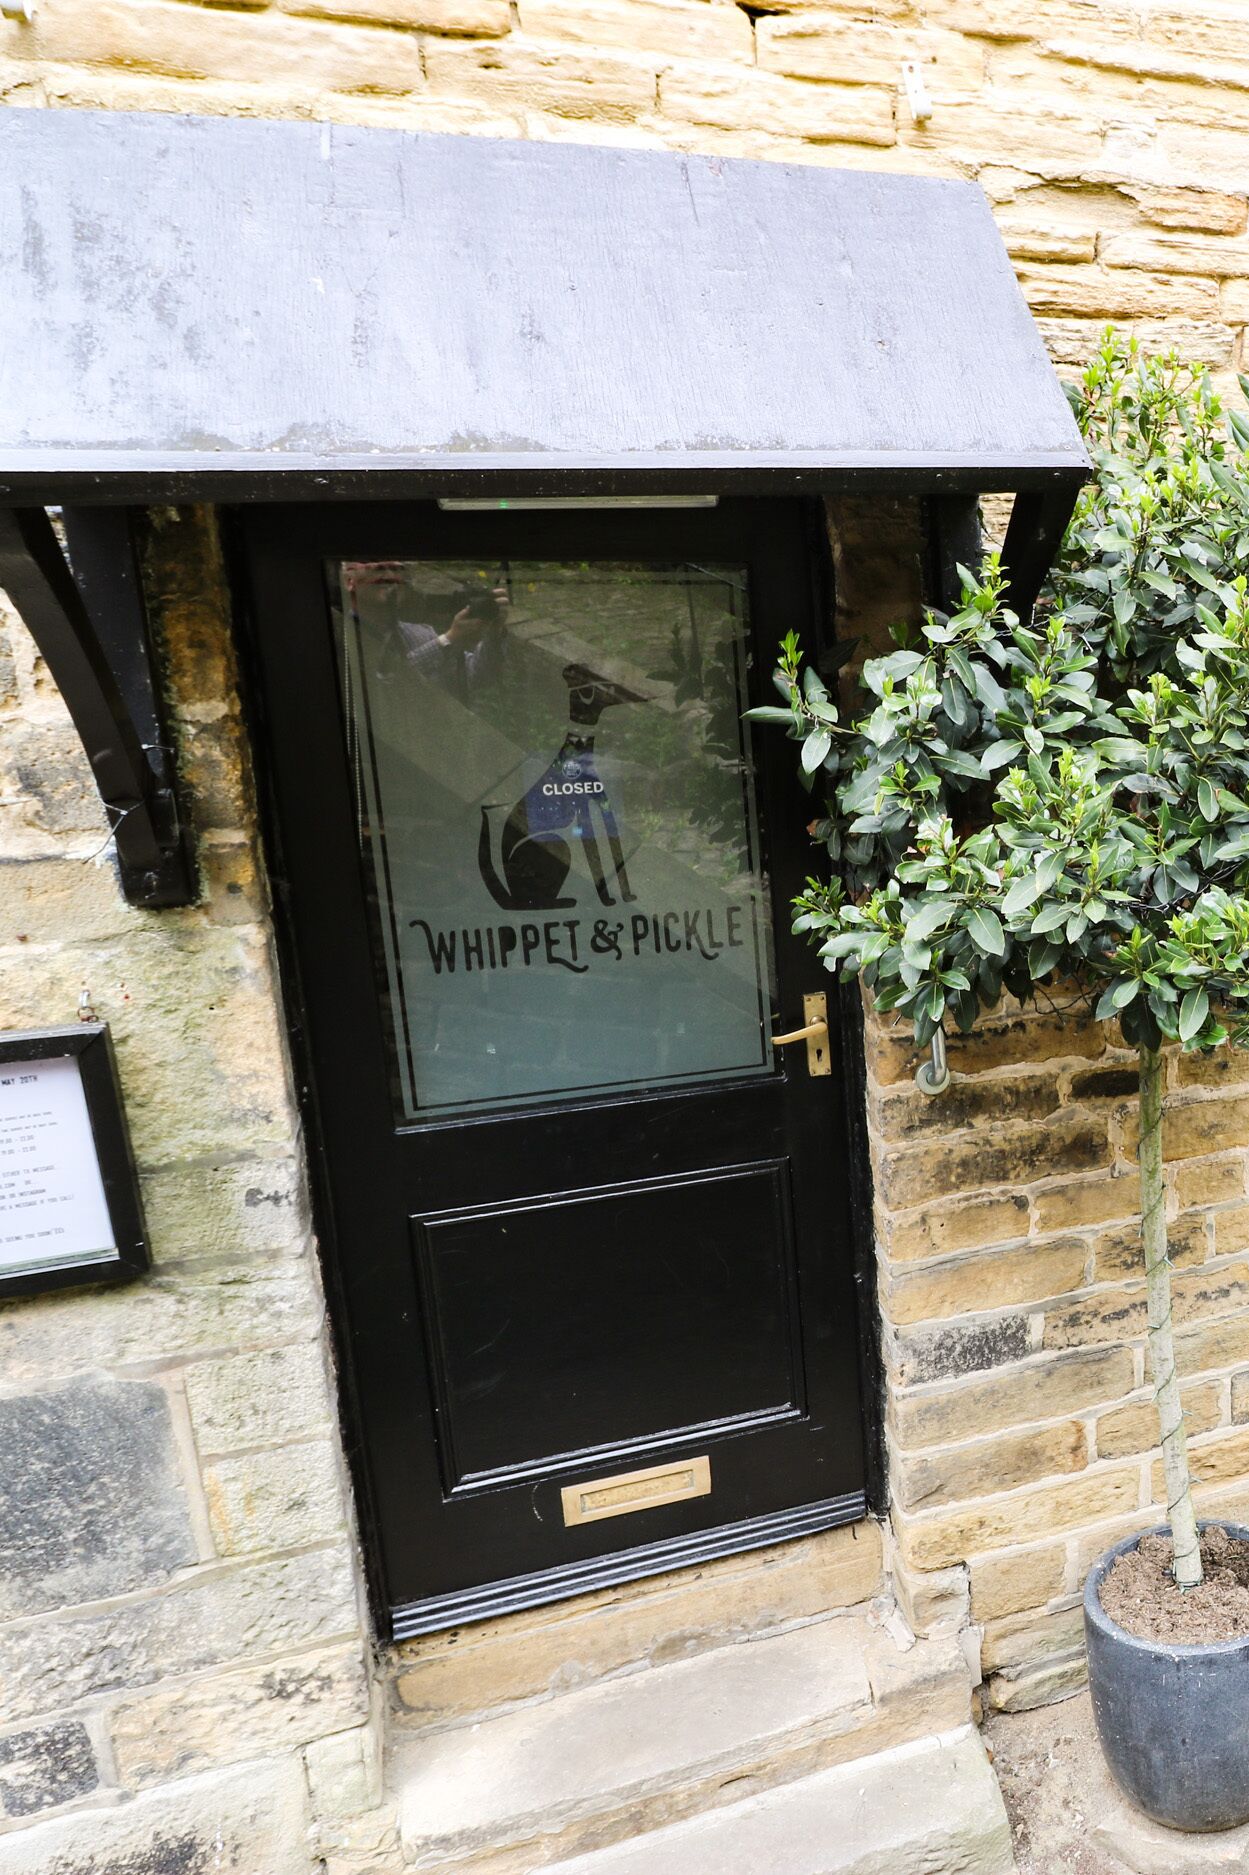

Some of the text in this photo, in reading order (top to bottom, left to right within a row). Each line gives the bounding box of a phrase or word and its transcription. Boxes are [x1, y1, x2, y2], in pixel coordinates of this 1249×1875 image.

[542, 781, 604, 796] CLOSED
[408, 905, 744, 974] WHIPPET & PICKLE
